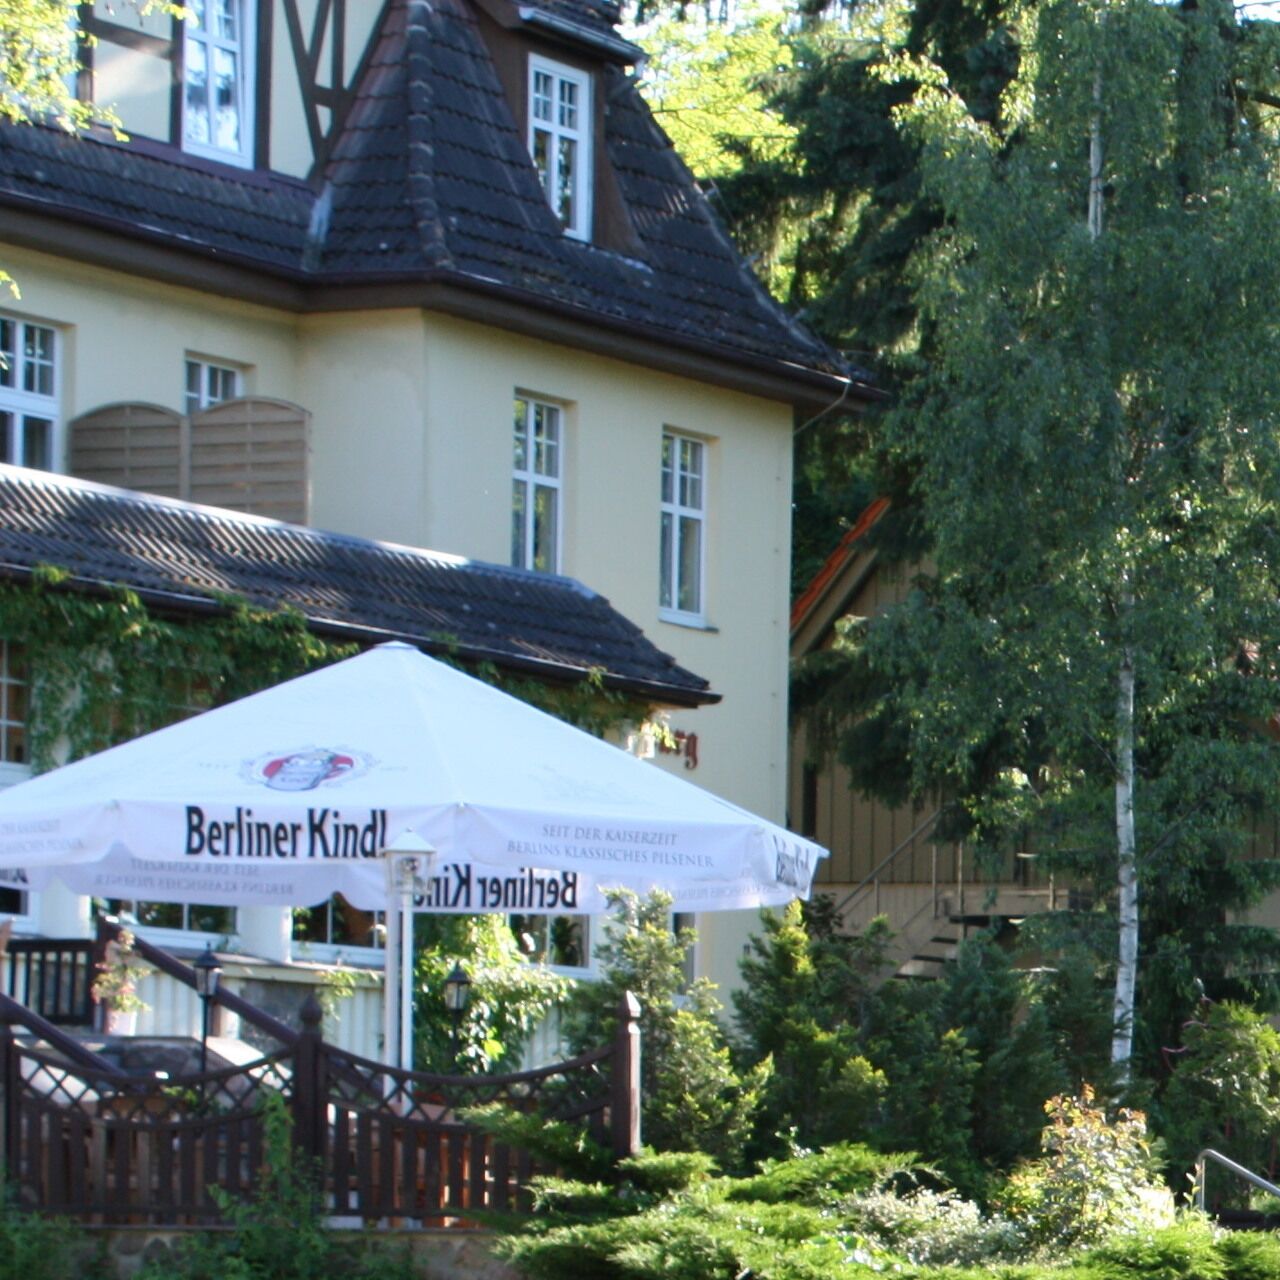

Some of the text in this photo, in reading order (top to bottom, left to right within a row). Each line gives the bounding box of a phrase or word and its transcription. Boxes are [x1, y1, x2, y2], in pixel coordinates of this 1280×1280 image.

[184, 805, 387, 859] Berliner Kindl
[542, 823, 679, 847] SEIT DER KAISERZEIT
[506, 839, 716, 869] BERLINS KLASSISCHES PILSENER
